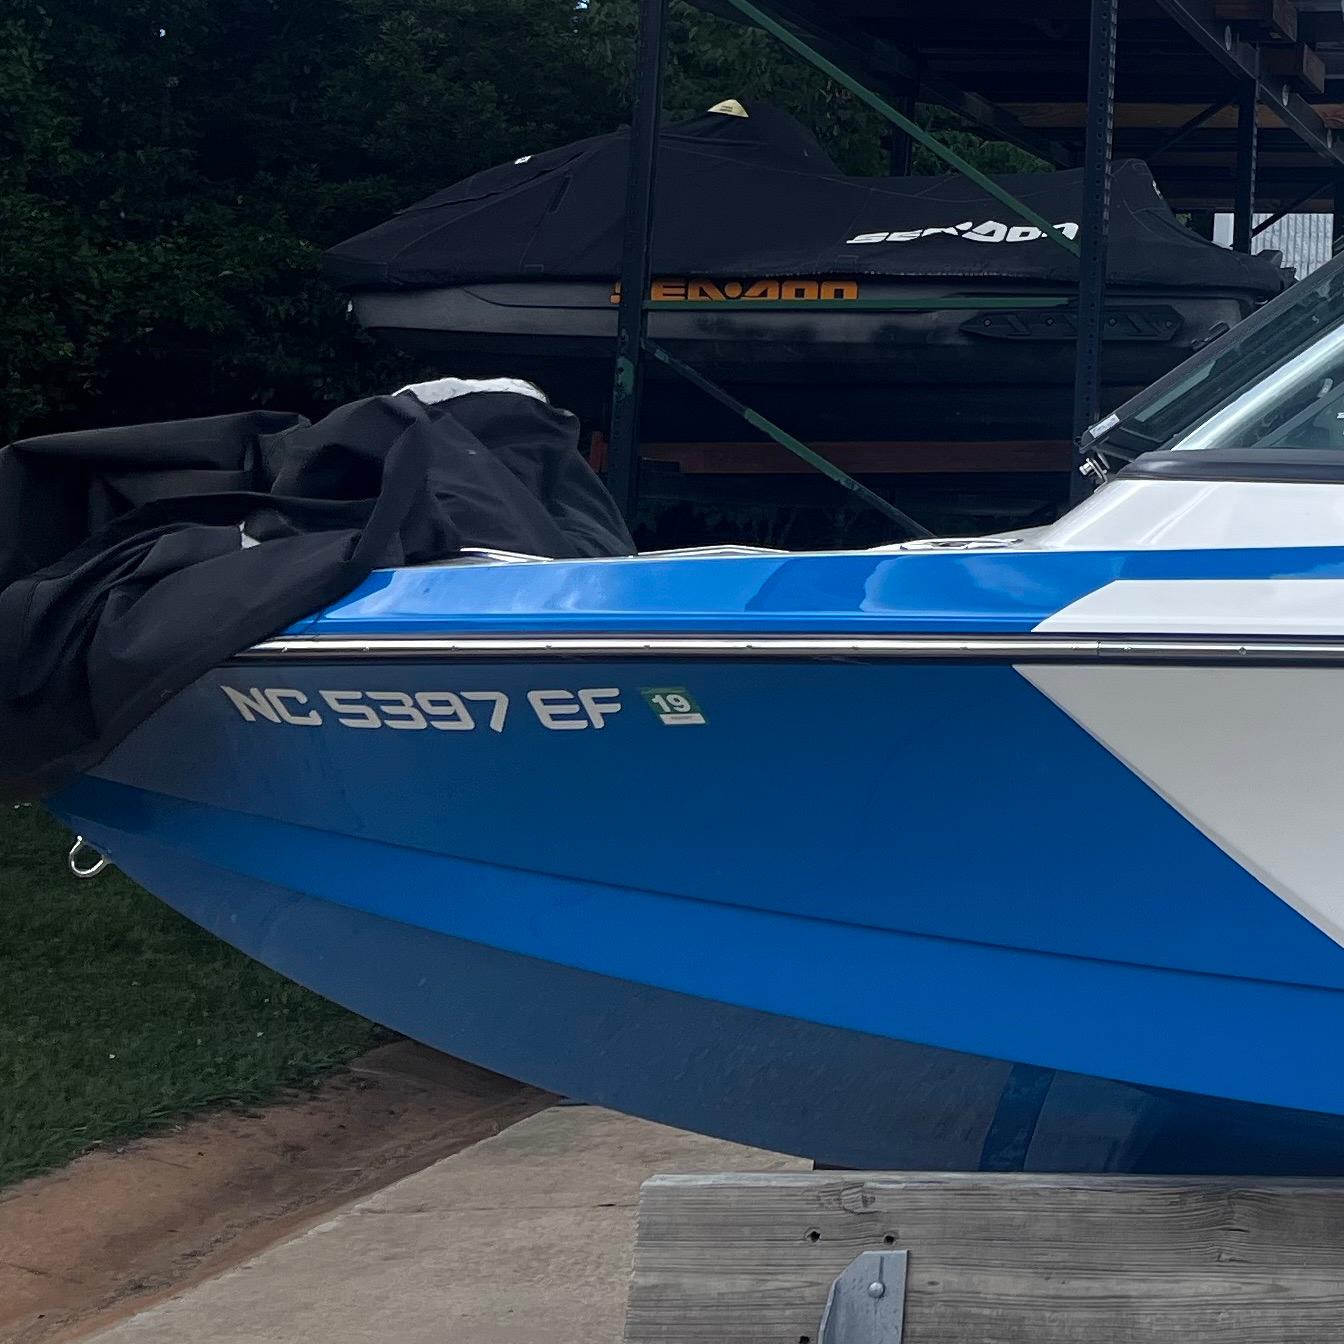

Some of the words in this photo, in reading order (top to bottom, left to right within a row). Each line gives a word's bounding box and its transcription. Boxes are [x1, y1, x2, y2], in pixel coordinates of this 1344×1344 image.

[221, 685, 323, 726] NC
[318, 689, 510, 734] 5397
[526, 687, 622, 731] EF
[651, 694, 691, 713] 19
